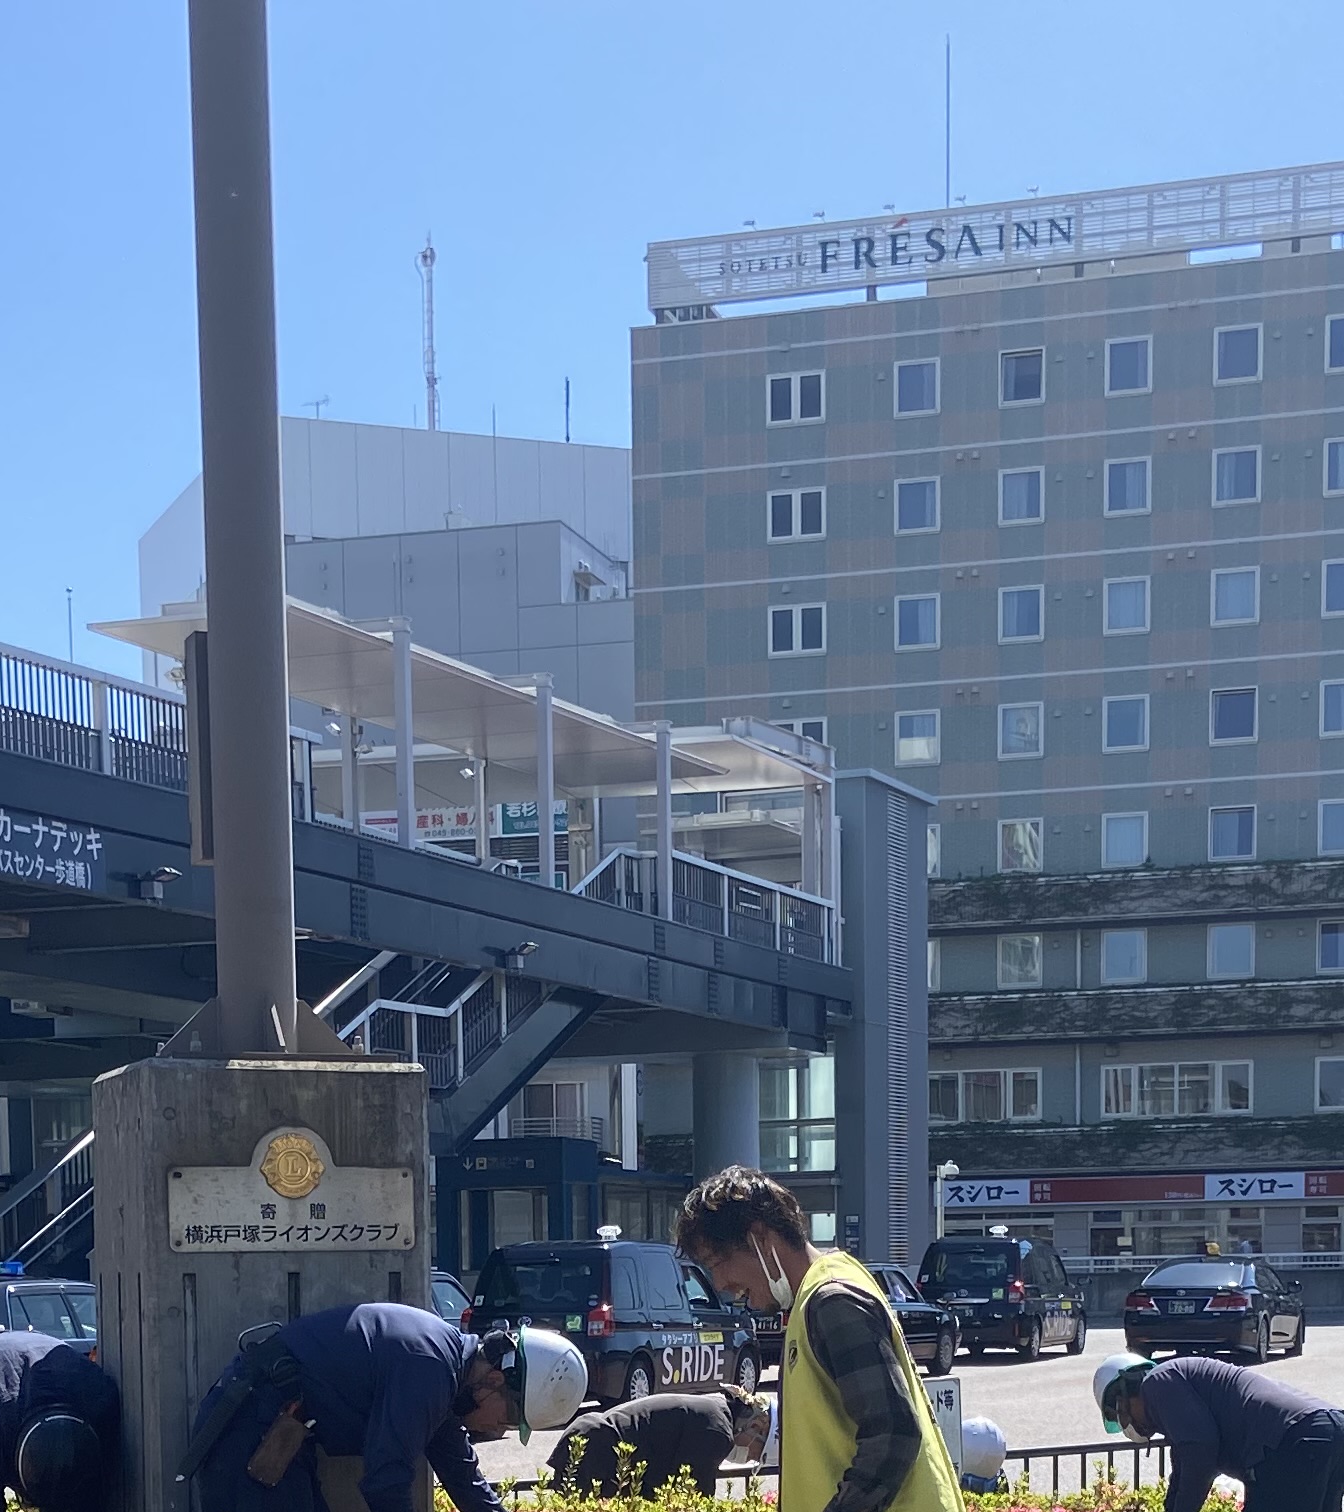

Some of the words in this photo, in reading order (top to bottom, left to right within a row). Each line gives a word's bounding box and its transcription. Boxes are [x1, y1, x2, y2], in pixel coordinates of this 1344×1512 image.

[818, 216, 983, 274] FRÉSA
[997, 216, 1073, 251] INN
[285, 1156, 302, 1177] L
[946, 1184, 1020, 1204] スシロー
[1216, 1177, 1294, 1197] スシロー
[184, 1223, 400, 1245] 横浜戸塚ライオンズクラブ
[661, 1344, 725, 1386] S.RIDE
[931, 1389, 954, 1412] ド等
